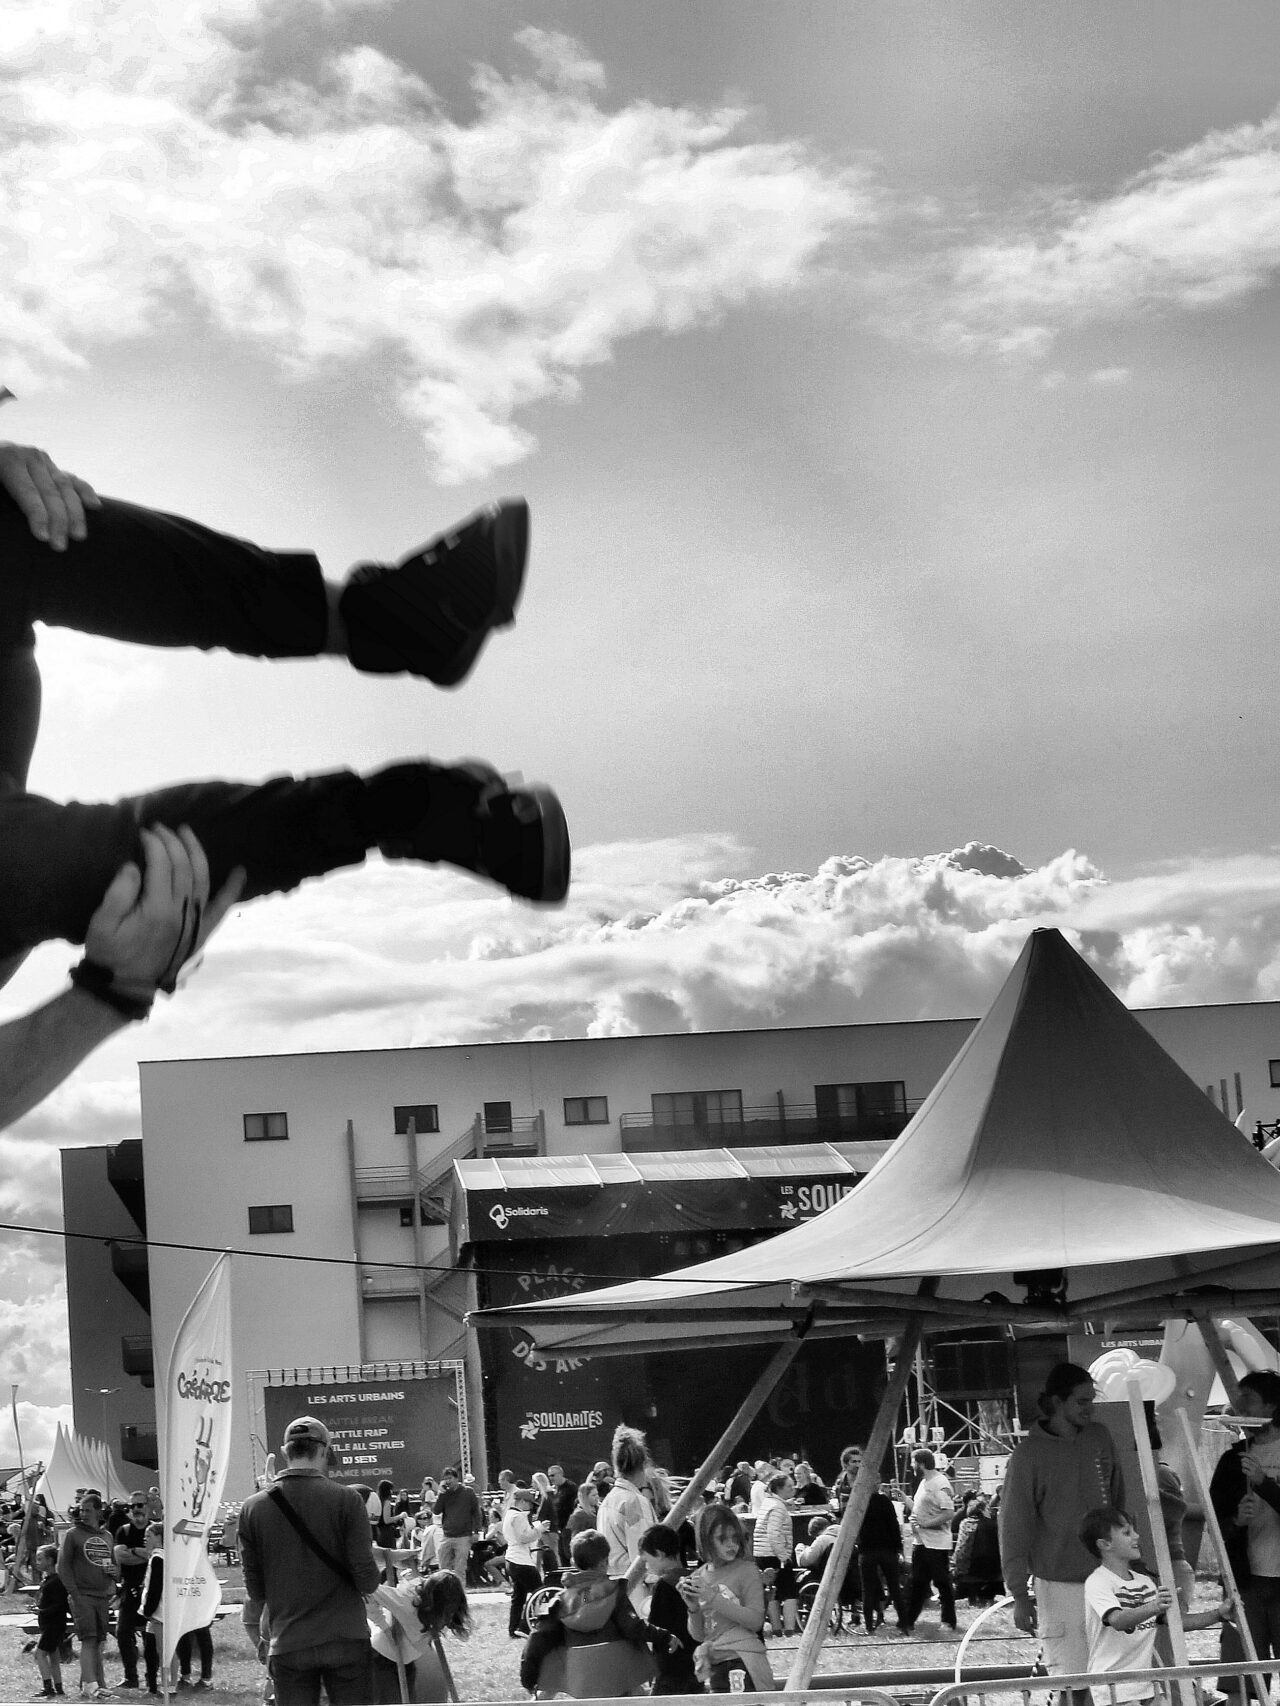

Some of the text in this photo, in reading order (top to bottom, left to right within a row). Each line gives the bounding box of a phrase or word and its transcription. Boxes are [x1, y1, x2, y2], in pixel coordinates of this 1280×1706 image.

[780, 1185, 794, 1195] LES
[504, 1206, 549, 1217] Solidaris
[517, 1264, 585, 1292] PLACE
[1138, 1339, 1164, 1347] URBA
[307, 1391, 405, 1405] LES ARTS URBAINS
[364, 1428, 388, 1438] RAP
[352, 1442, 368, 1451] ALL
[368, 1440, 406, 1450] STYLES
[342, 1455, 378, 1465] DJ SETS
[328, 1469, 360, 1478] DANCE
